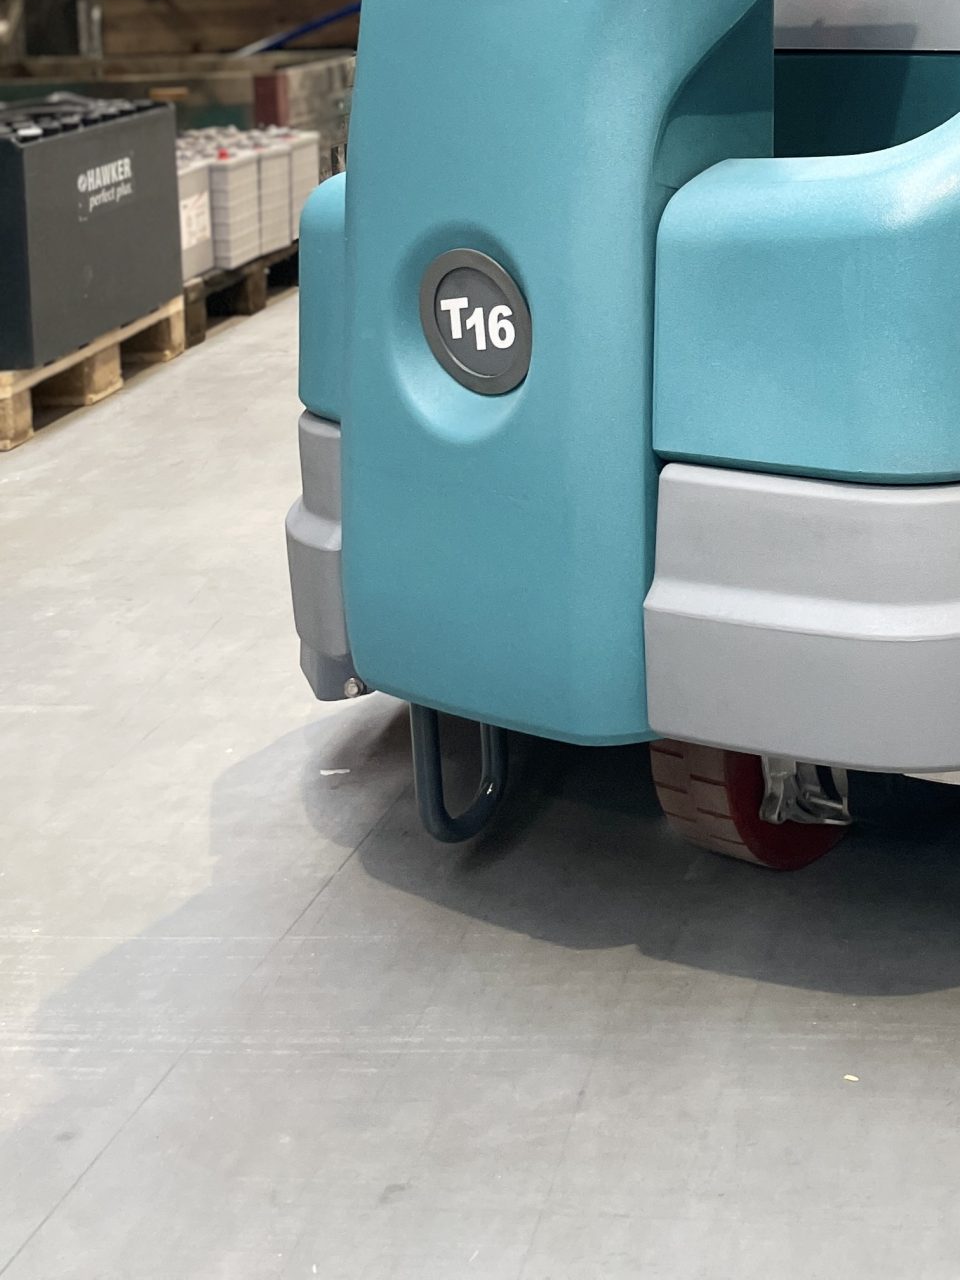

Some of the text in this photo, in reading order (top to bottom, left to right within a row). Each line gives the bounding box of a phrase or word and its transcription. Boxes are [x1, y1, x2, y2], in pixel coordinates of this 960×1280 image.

[86, 157, 132, 192] HAWKER
[89, 186, 115, 213] perfect
[440, 296, 515, 351] T16
